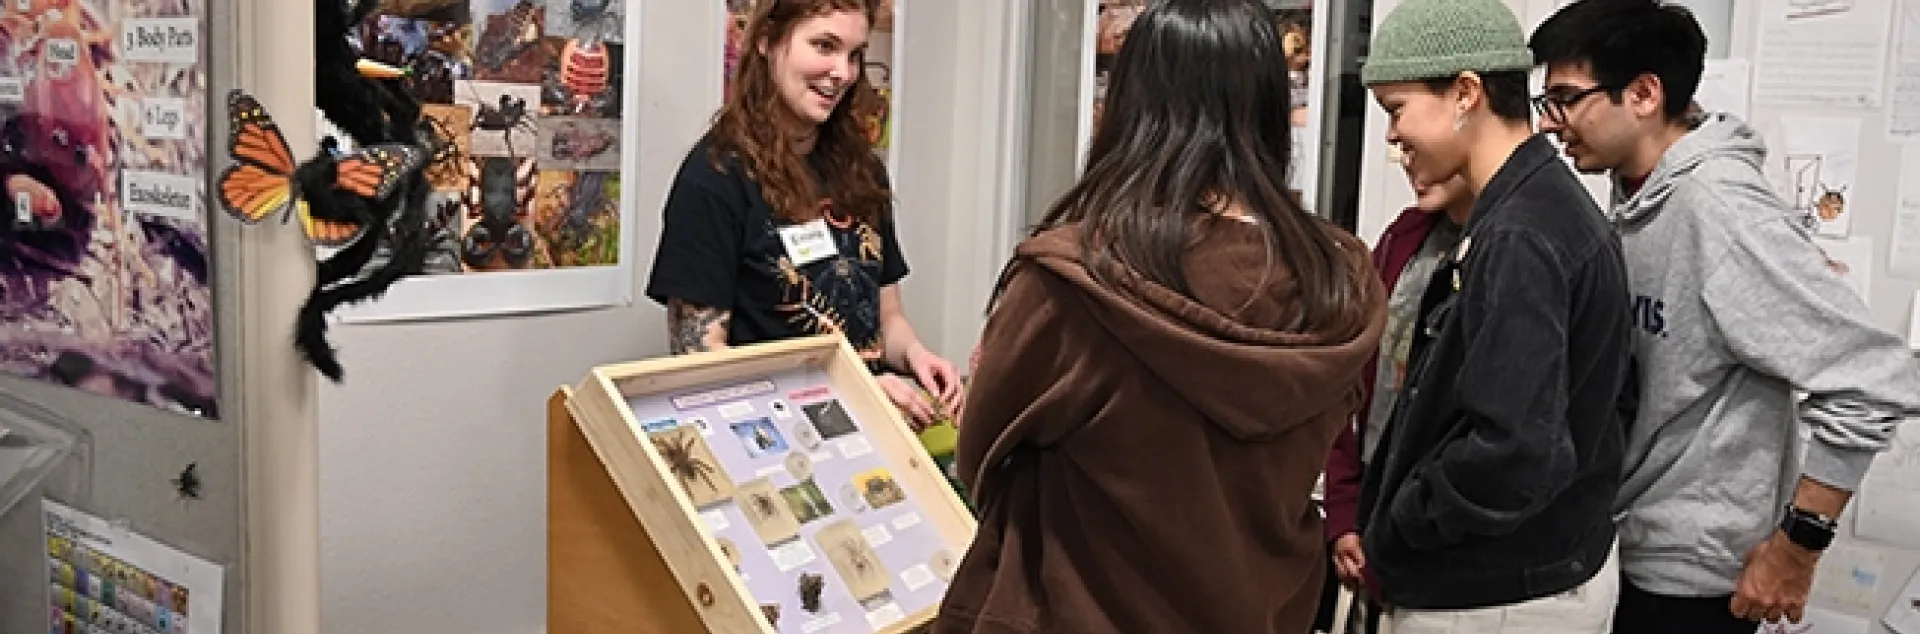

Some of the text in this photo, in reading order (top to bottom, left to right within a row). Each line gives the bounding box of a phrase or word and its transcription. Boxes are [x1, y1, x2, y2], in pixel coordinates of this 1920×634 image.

[126, 25, 194, 53] 3 Body Parts
[155, 105, 181, 131] Legs
[129, 182, 190, 208] Exoskeleton
